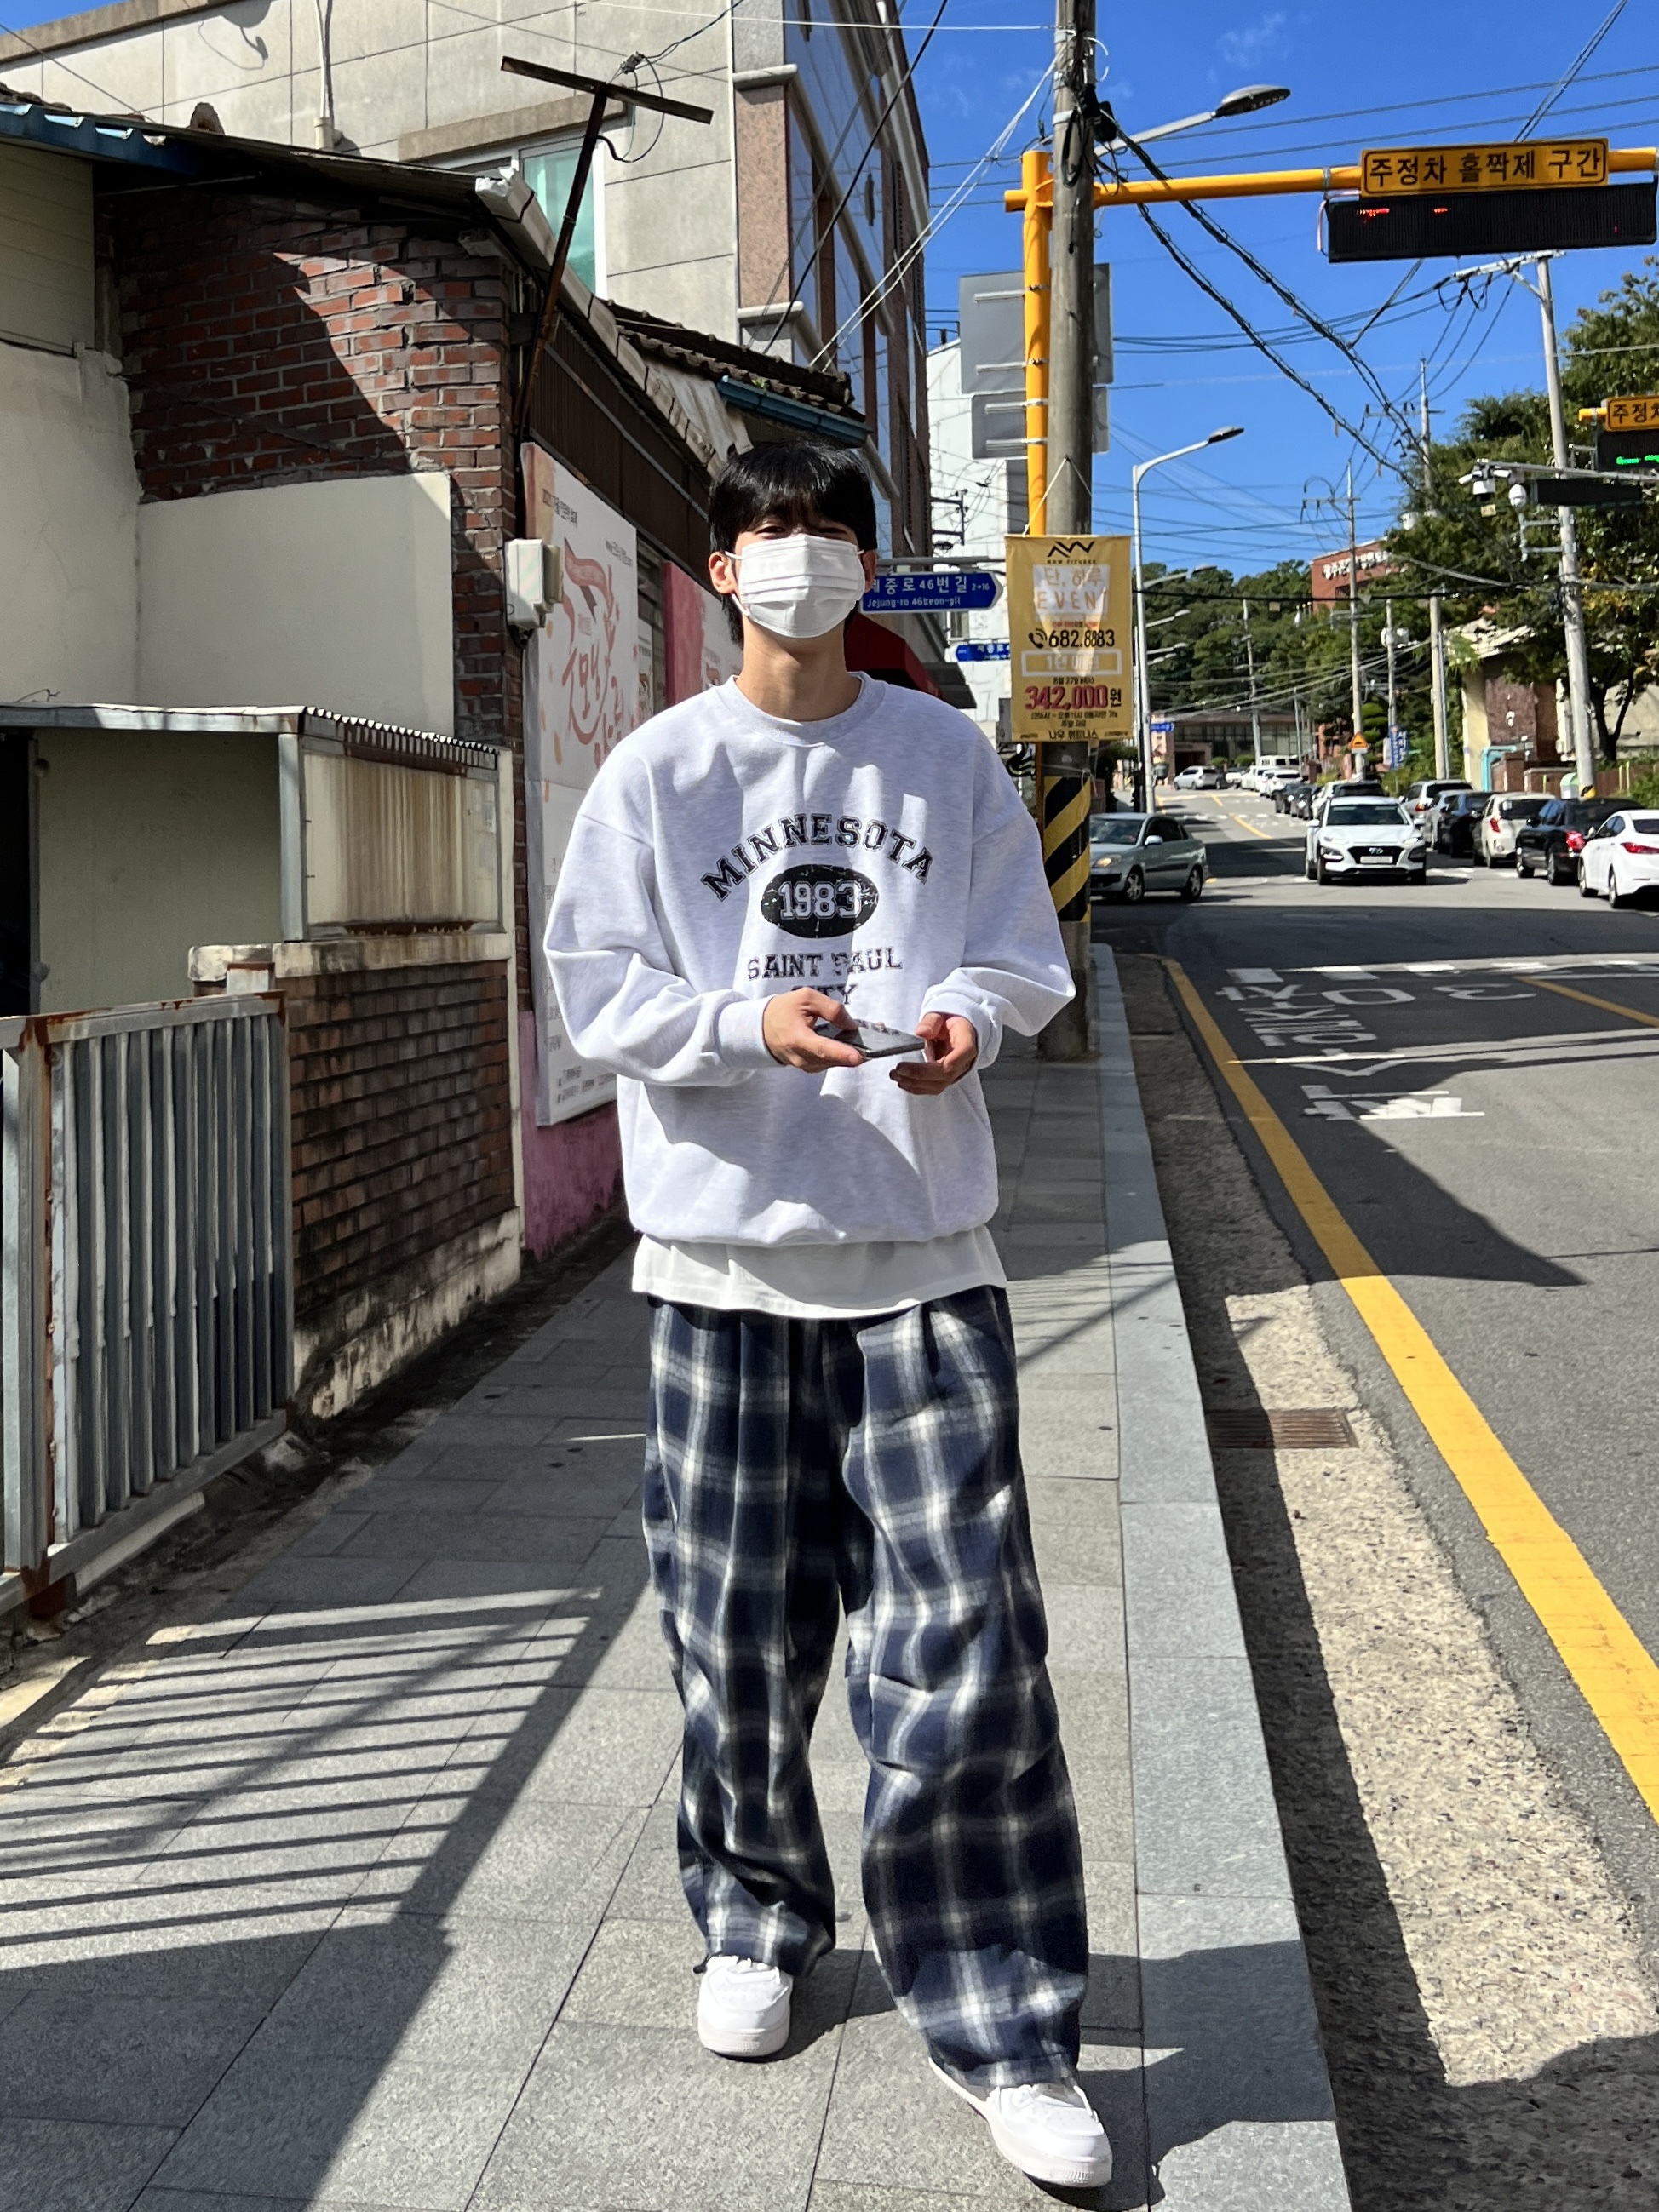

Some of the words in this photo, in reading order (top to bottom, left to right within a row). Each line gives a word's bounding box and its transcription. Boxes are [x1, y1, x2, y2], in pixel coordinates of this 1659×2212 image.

[1369, 158, 1447, 187] 주정차
[1458, 149, 1534, 183] 홀짝제
[1548, 148, 1600, 178] 구간
[867, 598, 910, 608] Jejung-ro
[700, 812, 934, 902] MINNESOTA
[778, 880, 864, 920] 1983
[747, 952, 823, 981] SAINT
